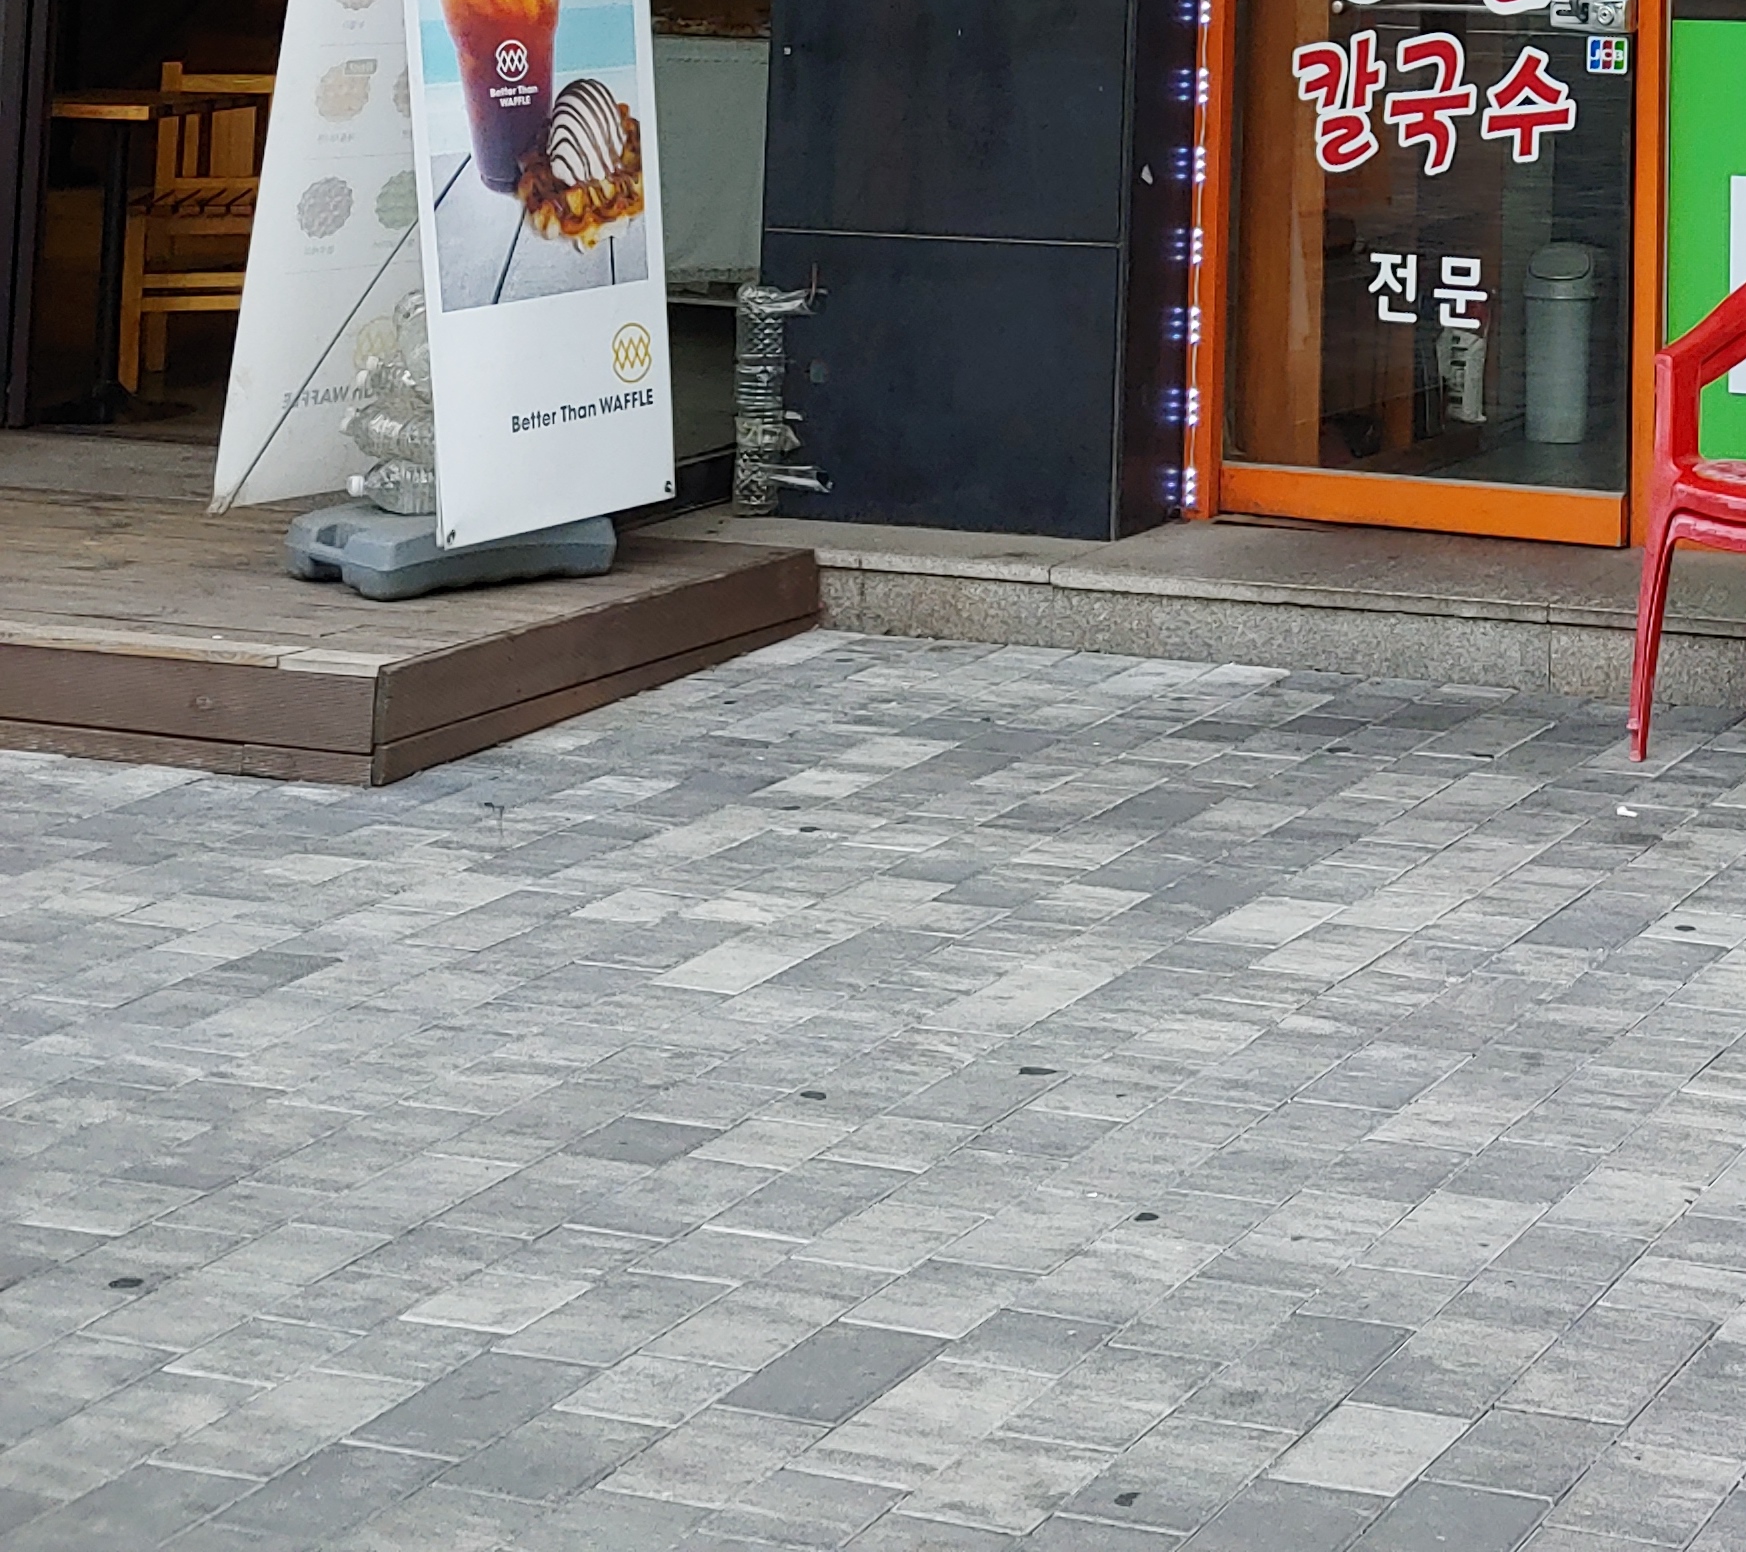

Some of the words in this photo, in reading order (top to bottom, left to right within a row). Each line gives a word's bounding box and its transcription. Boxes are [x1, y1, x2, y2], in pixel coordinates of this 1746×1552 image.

[1589, 39, 1625, 70] JCB
[1292, 29, 1577, 176] 칼국수
[1368, 252, 1488, 330] 전문
[511, 411, 557, 433] Better
[560, 403, 597, 423] Than
[599, 388, 654, 415] WAFFLE
